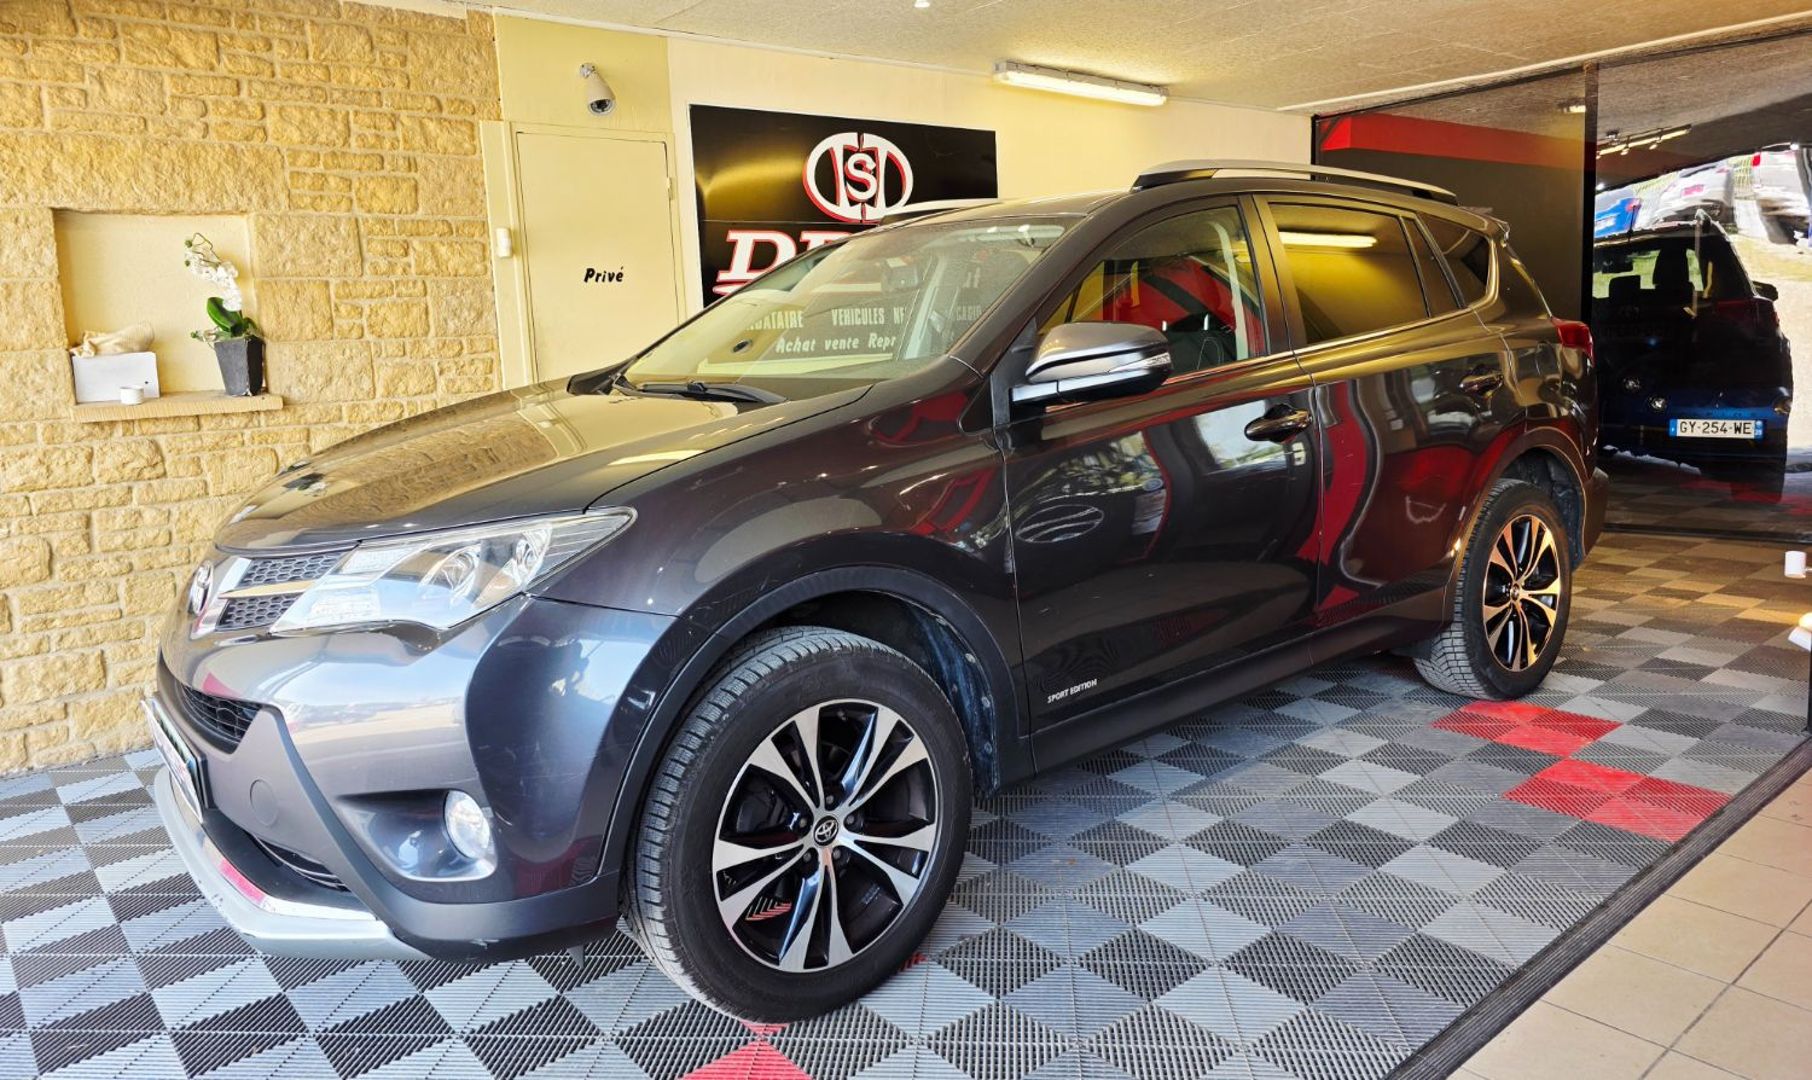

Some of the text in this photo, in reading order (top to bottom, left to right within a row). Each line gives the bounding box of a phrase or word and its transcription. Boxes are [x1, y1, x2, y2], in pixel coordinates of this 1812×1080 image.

[583, 265, 625, 283] Privé
[831, 307, 885, 326] VEHICULES
[776, 336, 816, 353] Achat
[824, 336, 860, 351] vente
[1679, 420, 1752, 435] GY-254-WE
[1047, 678, 1098, 704] SPORT EDITION
